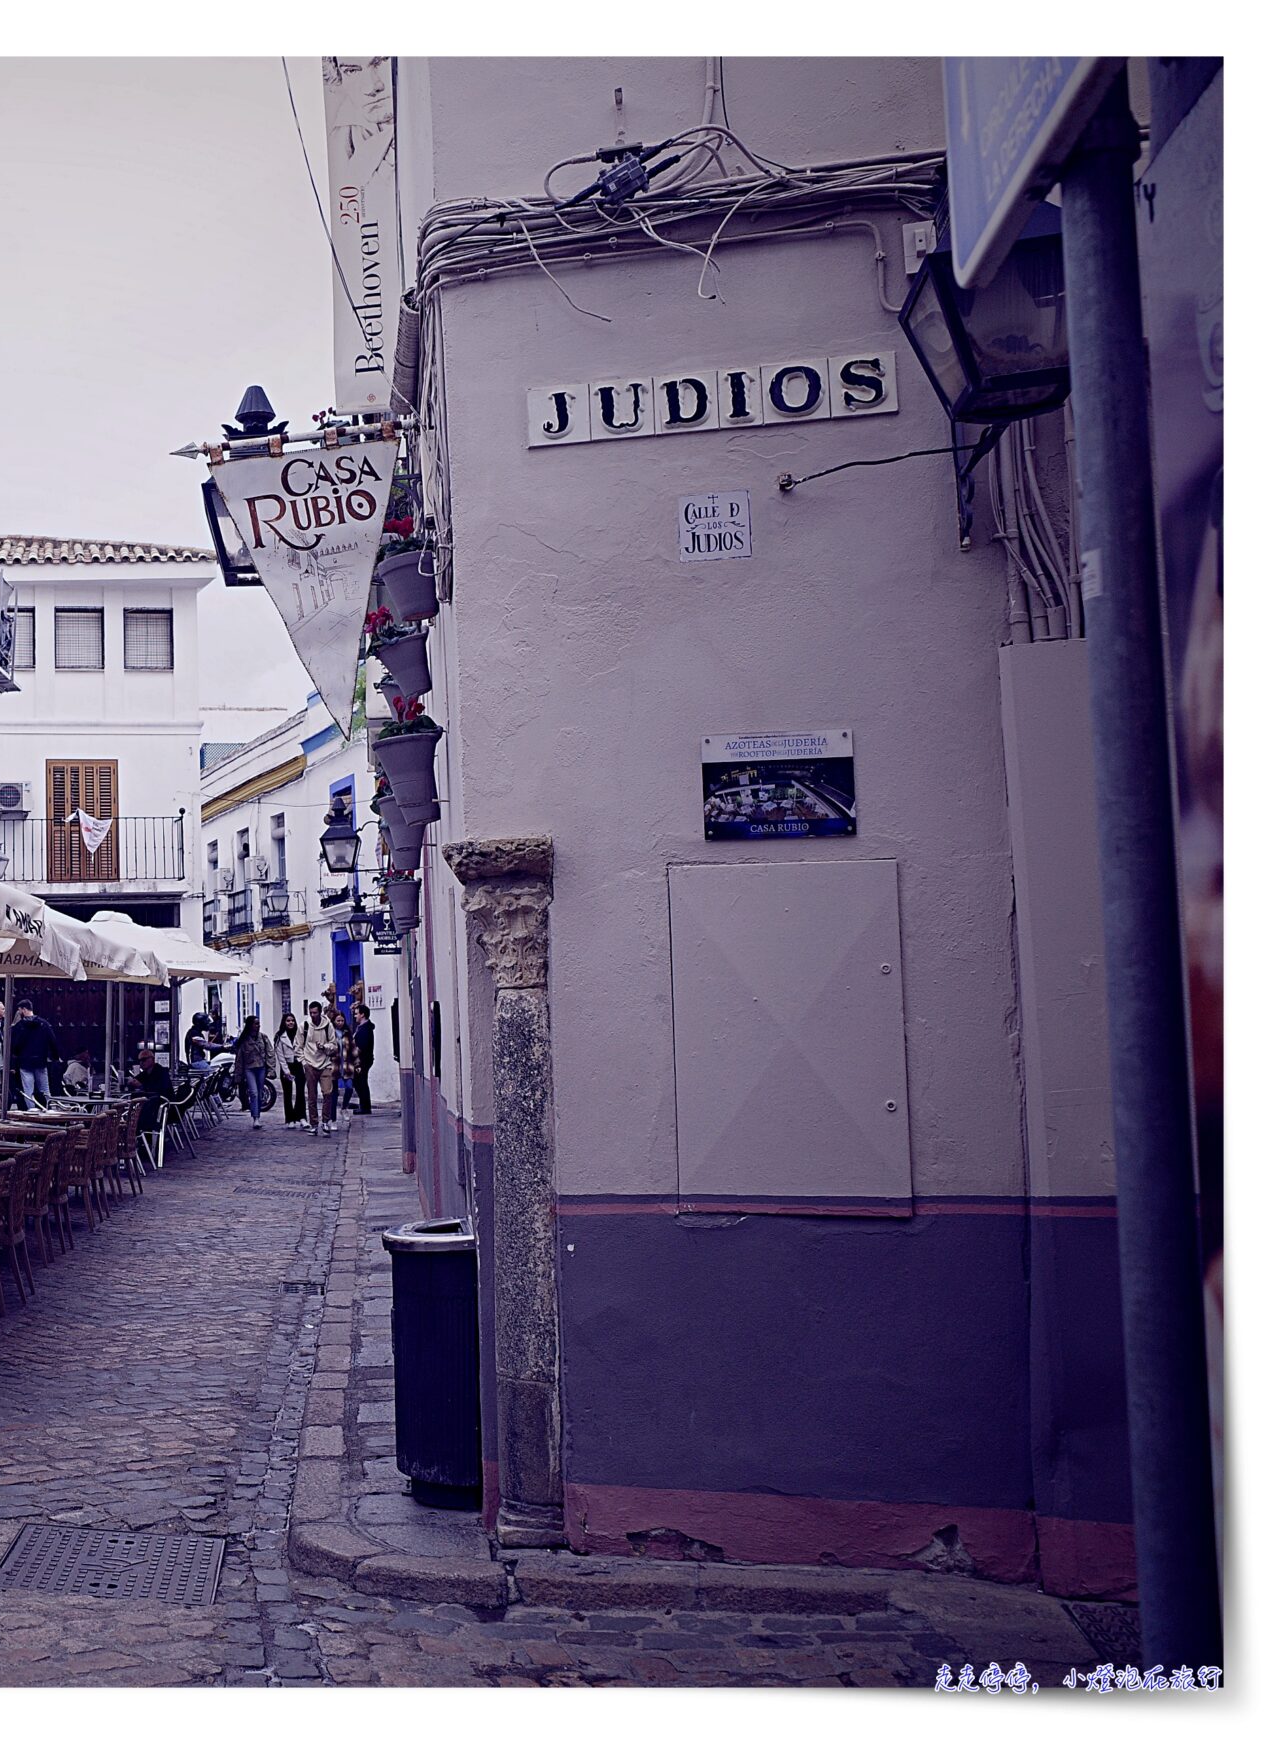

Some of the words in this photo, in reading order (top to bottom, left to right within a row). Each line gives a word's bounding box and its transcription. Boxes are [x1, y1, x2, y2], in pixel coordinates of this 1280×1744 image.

[338, 186, 360, 225] 250
[354, 219, 385, 376] Beethoven
[542, 357, 887, 437] JUDIOS
[281, 455, 382, 497] CASA
[684, 503, 720, 524] CALLE
[707, 521, 723, 530] LOS
[684, 531, 744, 553] JUDIOS
[725, 740, 771, 751] AZOTEAS
[738, 750, 777, 758] ROOFTOP
[750, 824, 776, 833] CASA
[777, 823, 810, 832] RUBIO
